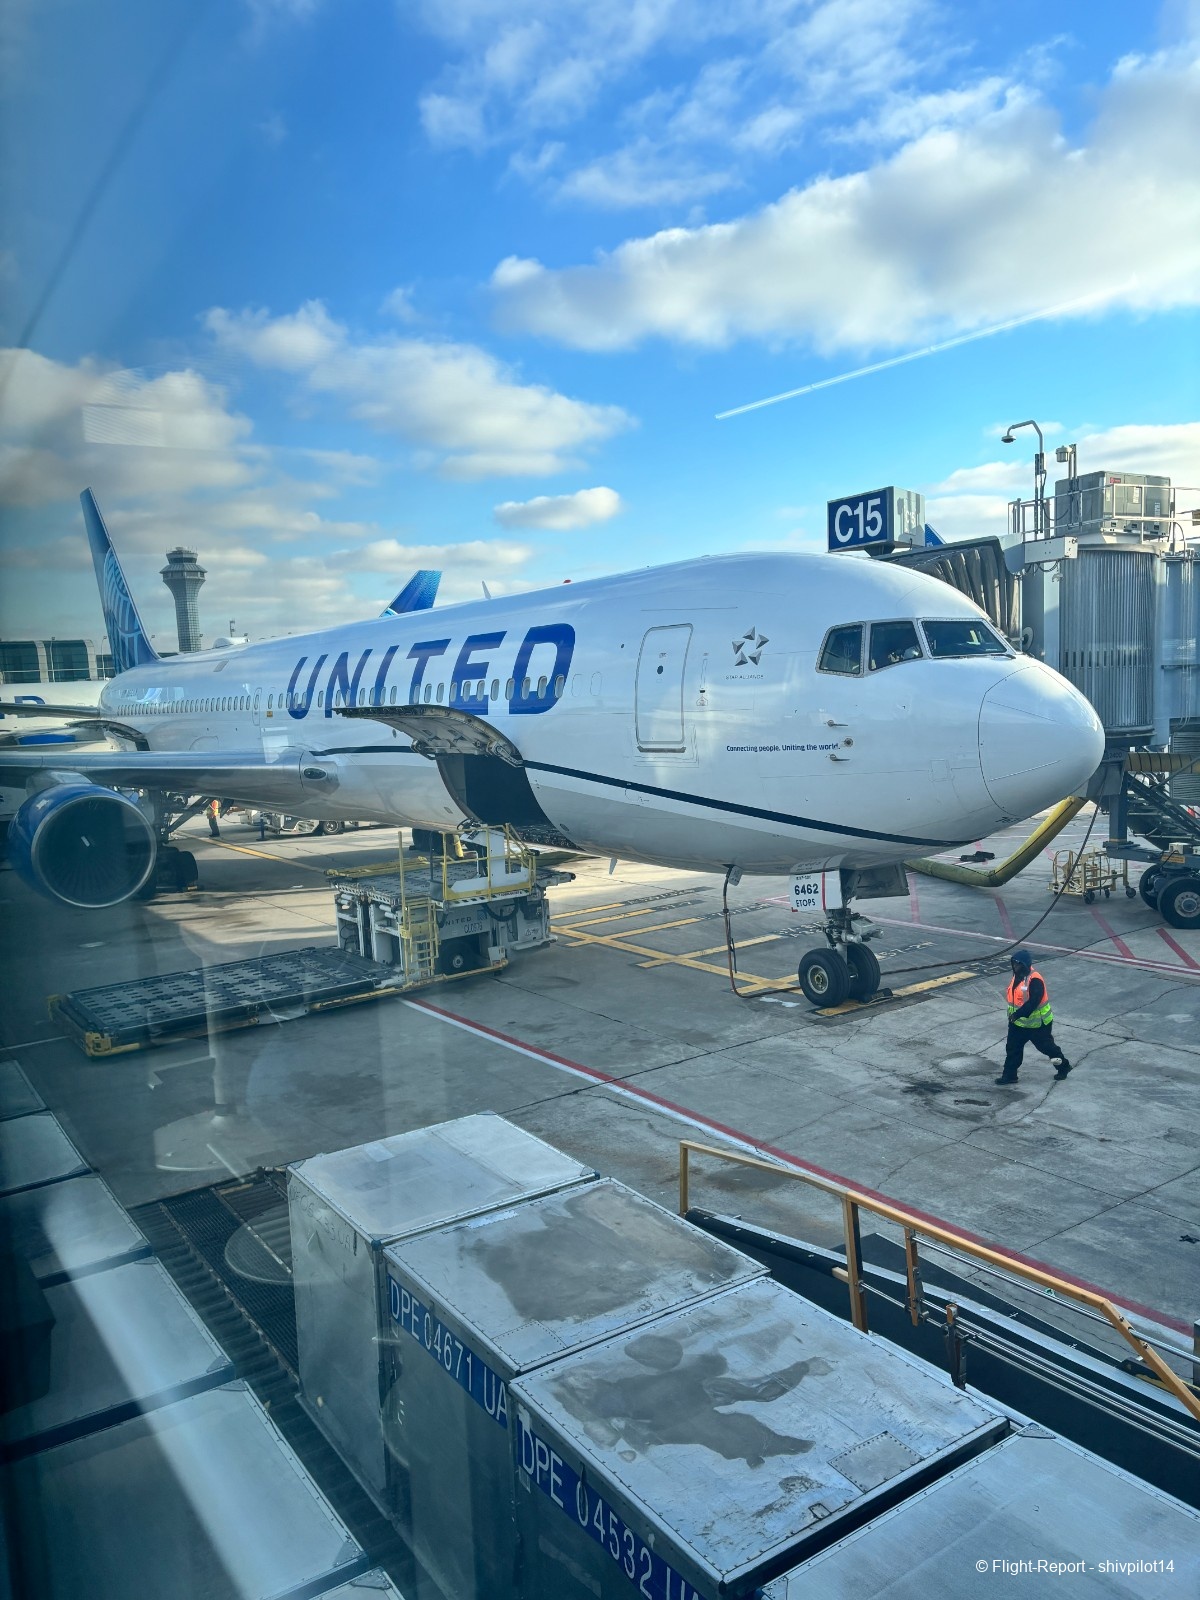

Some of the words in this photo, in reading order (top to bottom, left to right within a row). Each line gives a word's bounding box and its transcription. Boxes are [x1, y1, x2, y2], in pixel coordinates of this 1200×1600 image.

[834, 498, 883, 543] C15
[286, 623, 576, 720] UNITED
[781, 744, 805, 752] Uniting
[806, 743, 818, 751] the
[794, 883, 819, 896] 6462
[796, 898, 816, 908] ETOPS
[443, 916, 472, 927] NITED
[390, 1278, 420, 1341] DPE
[424, 1312, 472, 1392] 04671
[483, 1365, 508, 1421] UA
[521, 1420, 564, 1509] DPE
[575, 1479, 653, 1600] 04532
